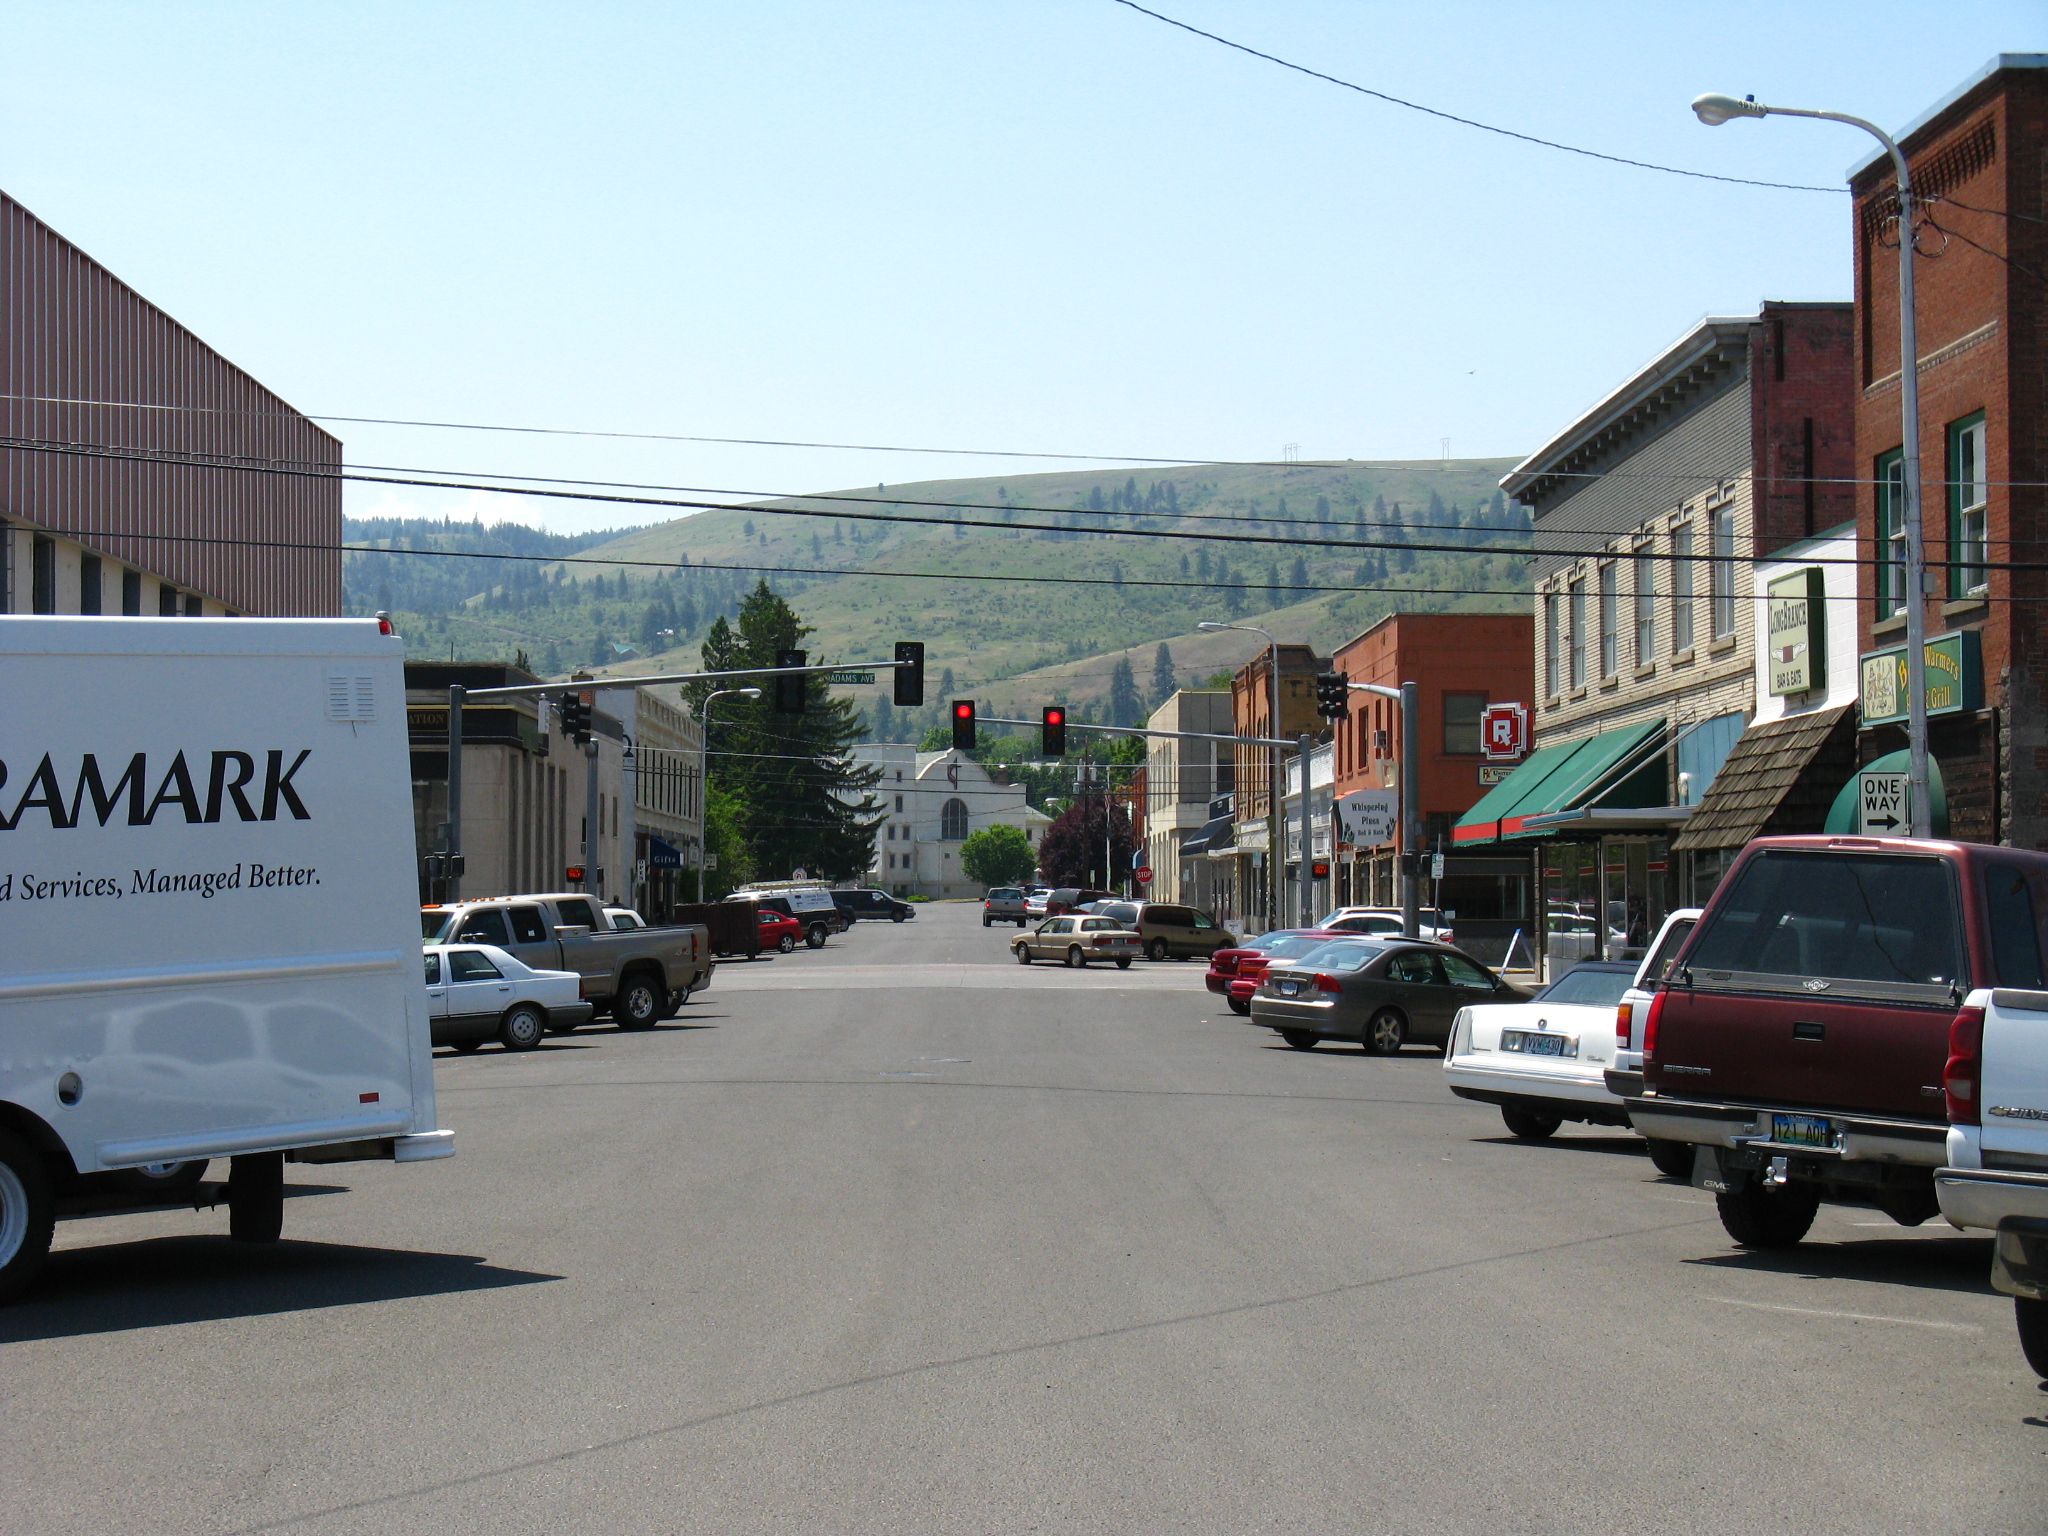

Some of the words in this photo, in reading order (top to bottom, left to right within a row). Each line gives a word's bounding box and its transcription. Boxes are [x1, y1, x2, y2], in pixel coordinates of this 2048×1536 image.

[1924, 646, 1959, 682] Warmers
[830, 674, 857, 683] ADAMS
[861, 674, 875, 683] AVE
[1776, 673, 1786, 689] BAR
[1790, 668, 1802, 686] EATS
[1931, 686, 1951, 709] Grill
[1865, 779, 1900, 794] ONE
[1351, 803, 1389, 813] Whispering
[1865, 796, 1900, 811] WAY
[1361, 816, 1380, 825] Pines
[653, 855, 677, 865] Gifts
[20, 871, 123, 901] Services,
[130, 862, 242, 899] Managed
[248, 863, 321, 888] Better.
[1663, 1063, 1712, 1076] SIERRA
[1777, 1121, 1797, 1140] 121
[1703, 1179, 1731, 1190] GMC
